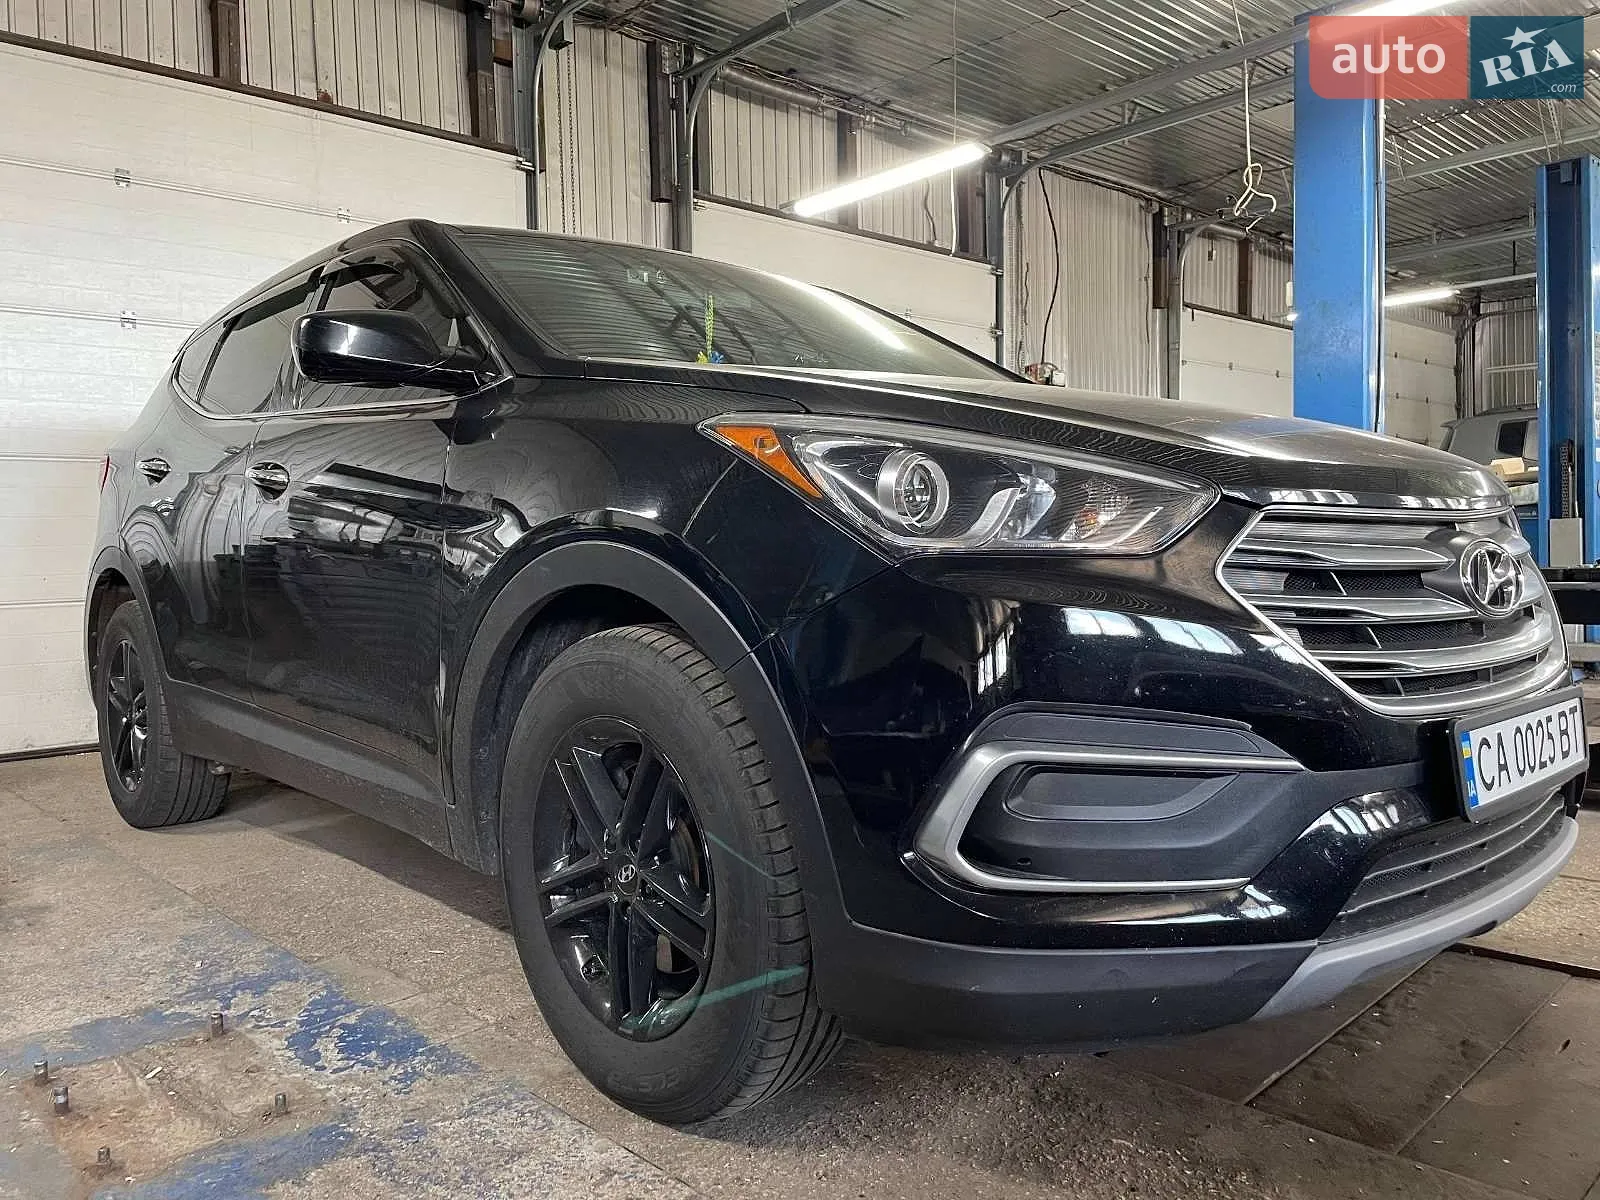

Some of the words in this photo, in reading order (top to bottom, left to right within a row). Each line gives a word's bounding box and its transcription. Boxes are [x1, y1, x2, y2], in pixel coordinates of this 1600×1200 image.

[1478, 732, 1511, 791] CA
[1514, 715, 1556, 777] 0025
[1558, 705, 1578, 760] BT
